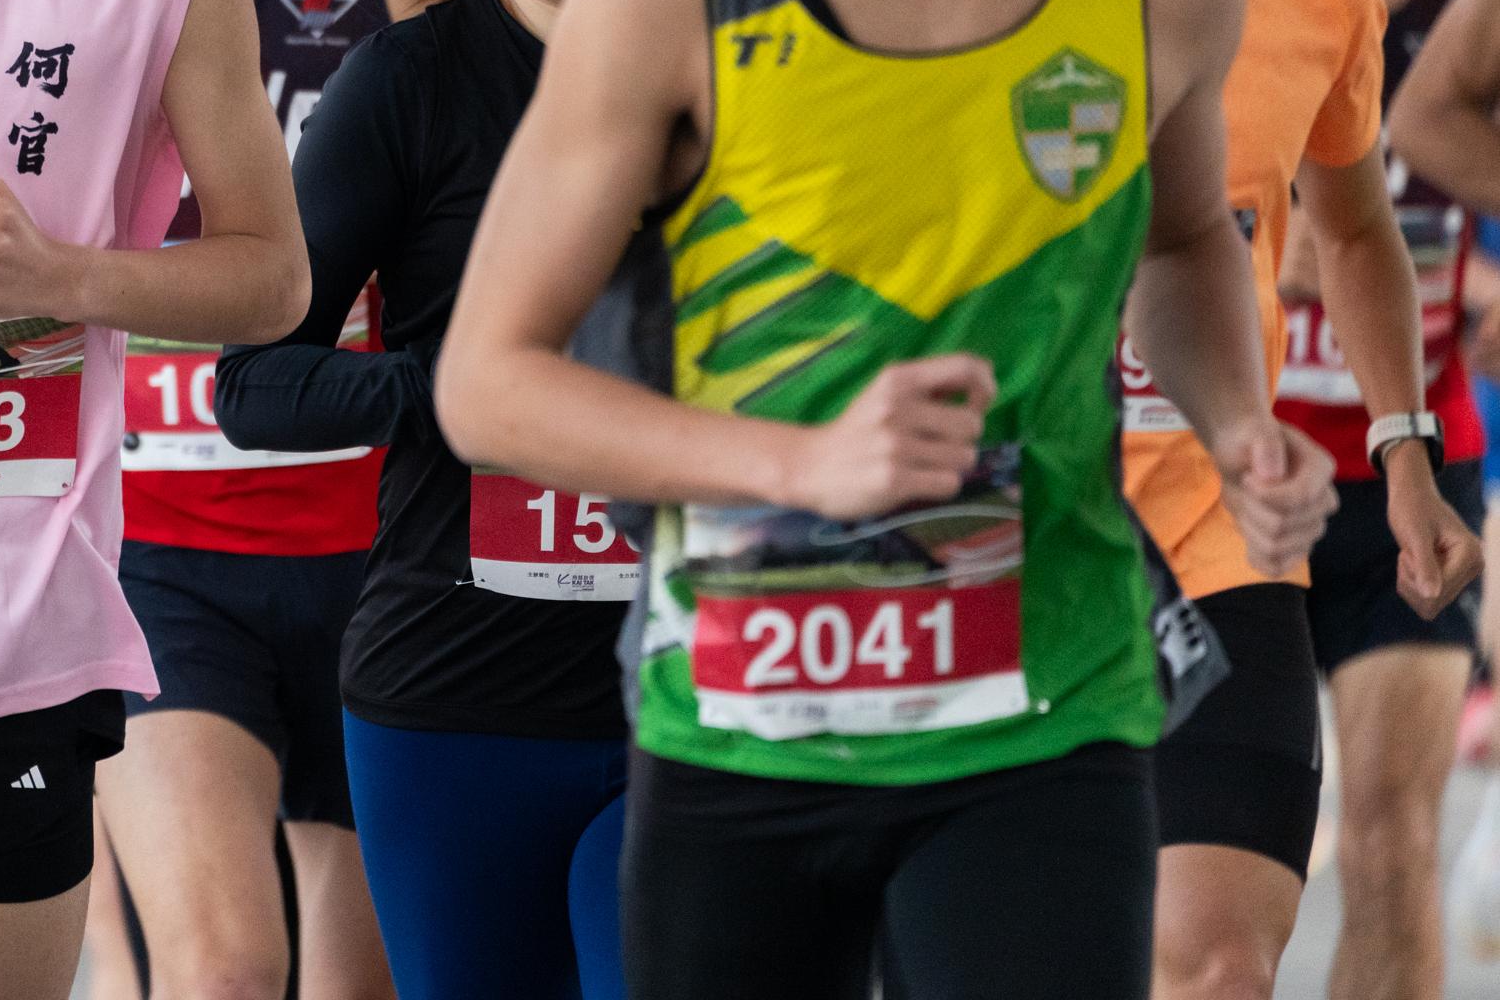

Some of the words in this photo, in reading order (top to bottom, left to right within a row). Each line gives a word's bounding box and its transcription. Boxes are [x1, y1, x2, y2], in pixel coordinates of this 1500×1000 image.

[5, 41, 75, 176] 何官
[526, 490, 642, 554] 15
[743, 599, 955, 688] 2041
